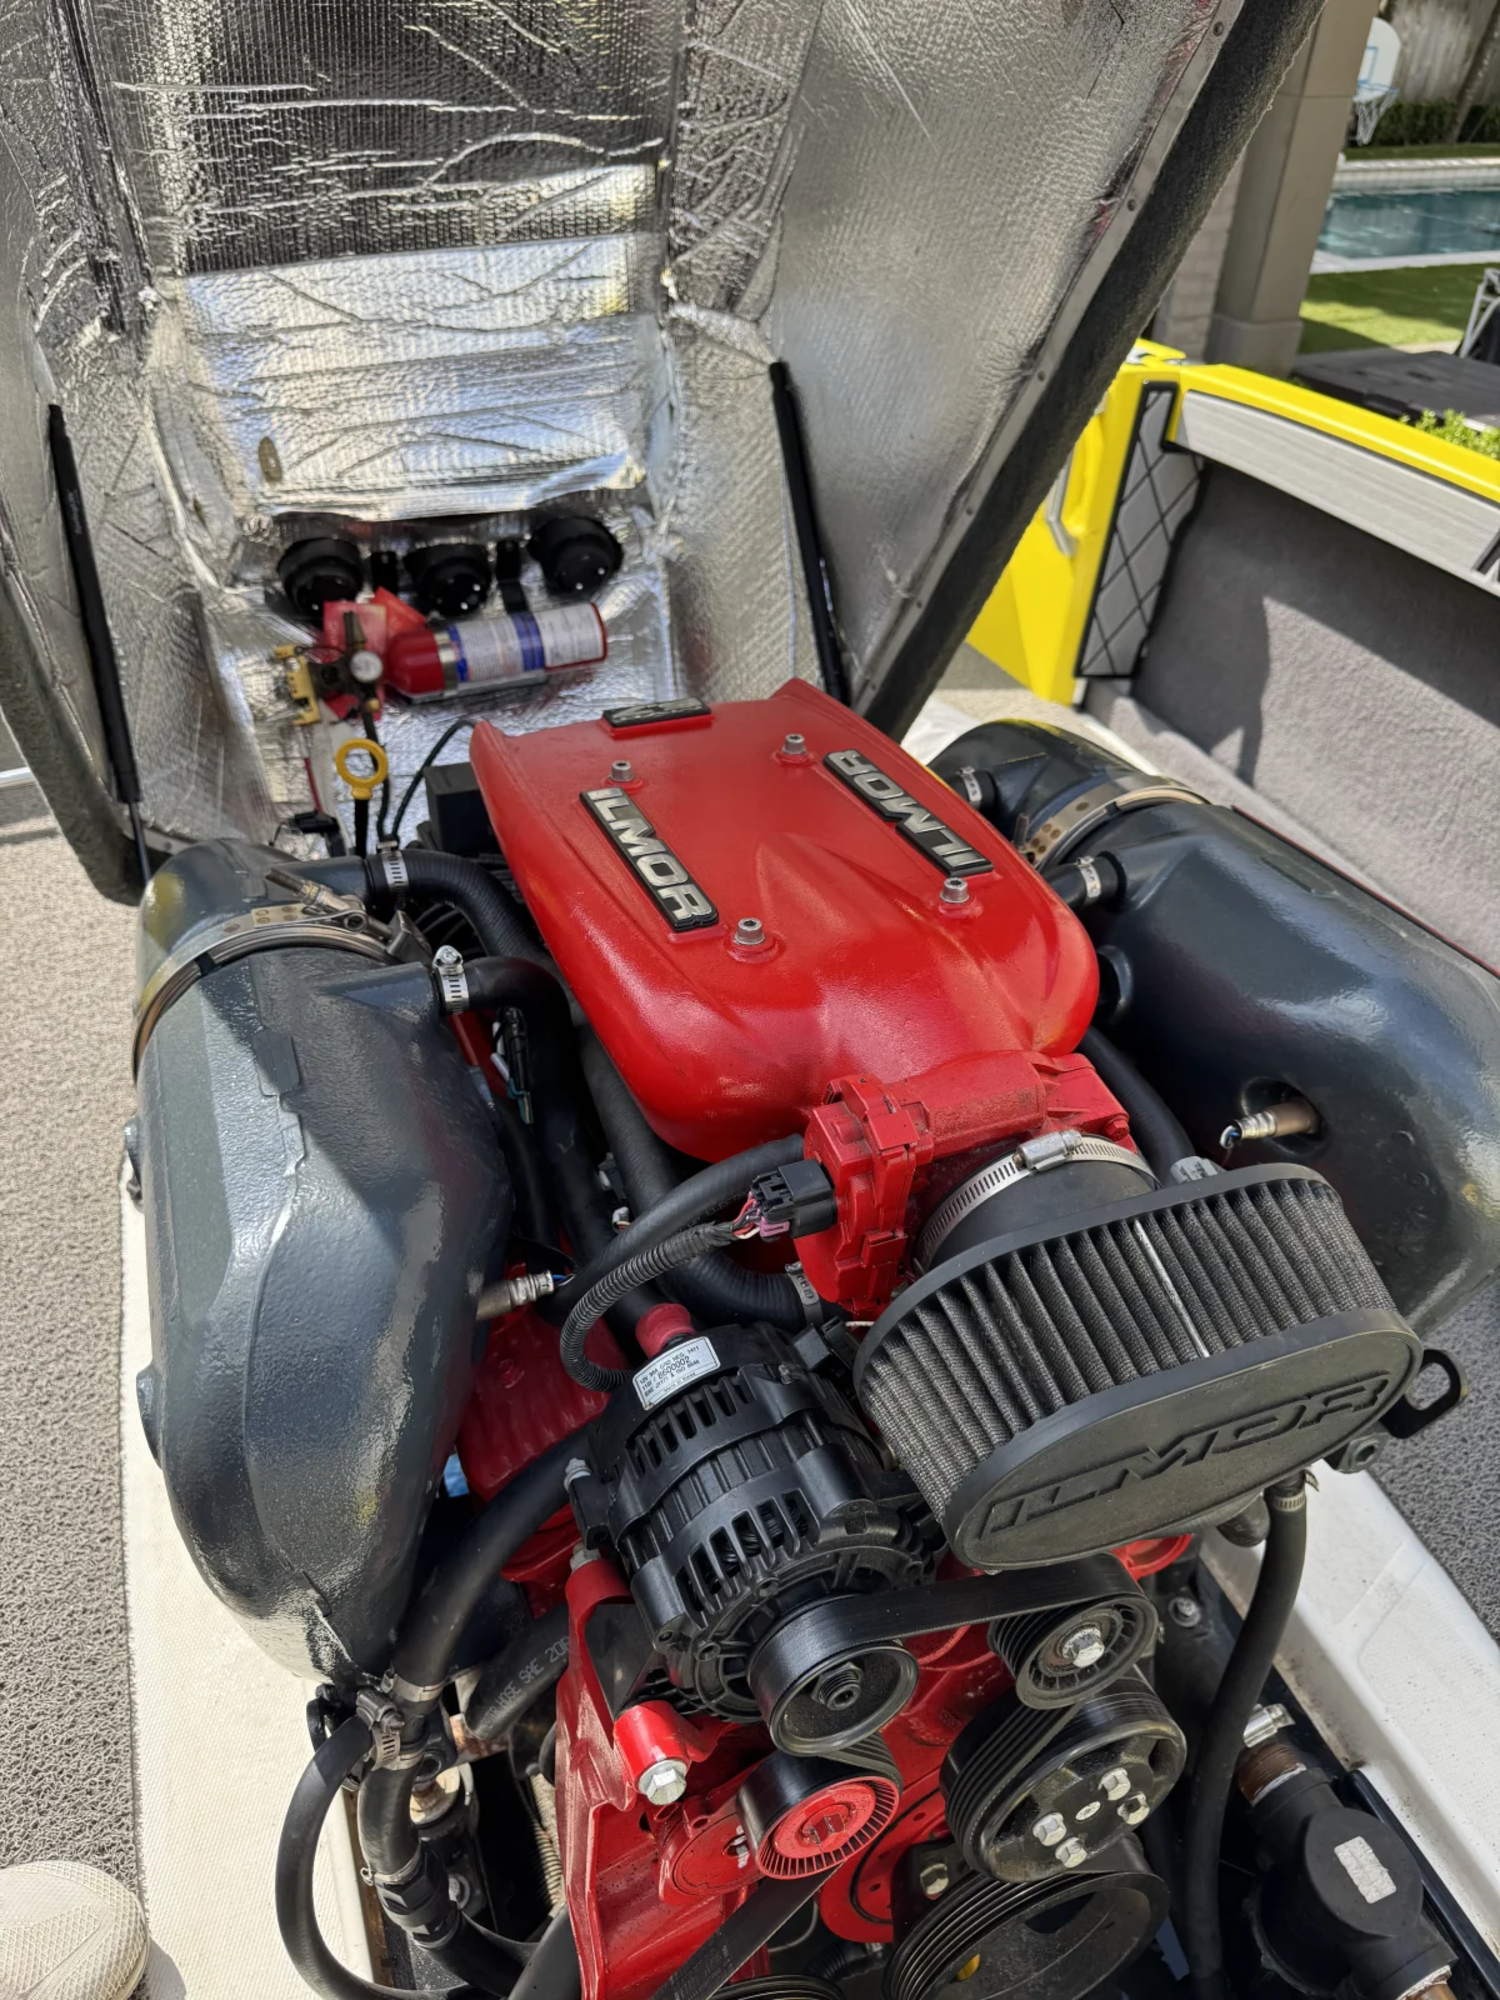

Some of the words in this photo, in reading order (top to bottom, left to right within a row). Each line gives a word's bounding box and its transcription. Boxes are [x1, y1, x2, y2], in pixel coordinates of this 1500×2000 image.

[586, 788, 714, 921] ILMOR
[827, 749, 988, 866] ILMOR
[979, 1372, 1391, 1539] ILMOR
[494, 1680, 522, 1707] HOSE
[518, 1658, 545, 1684] SAE
